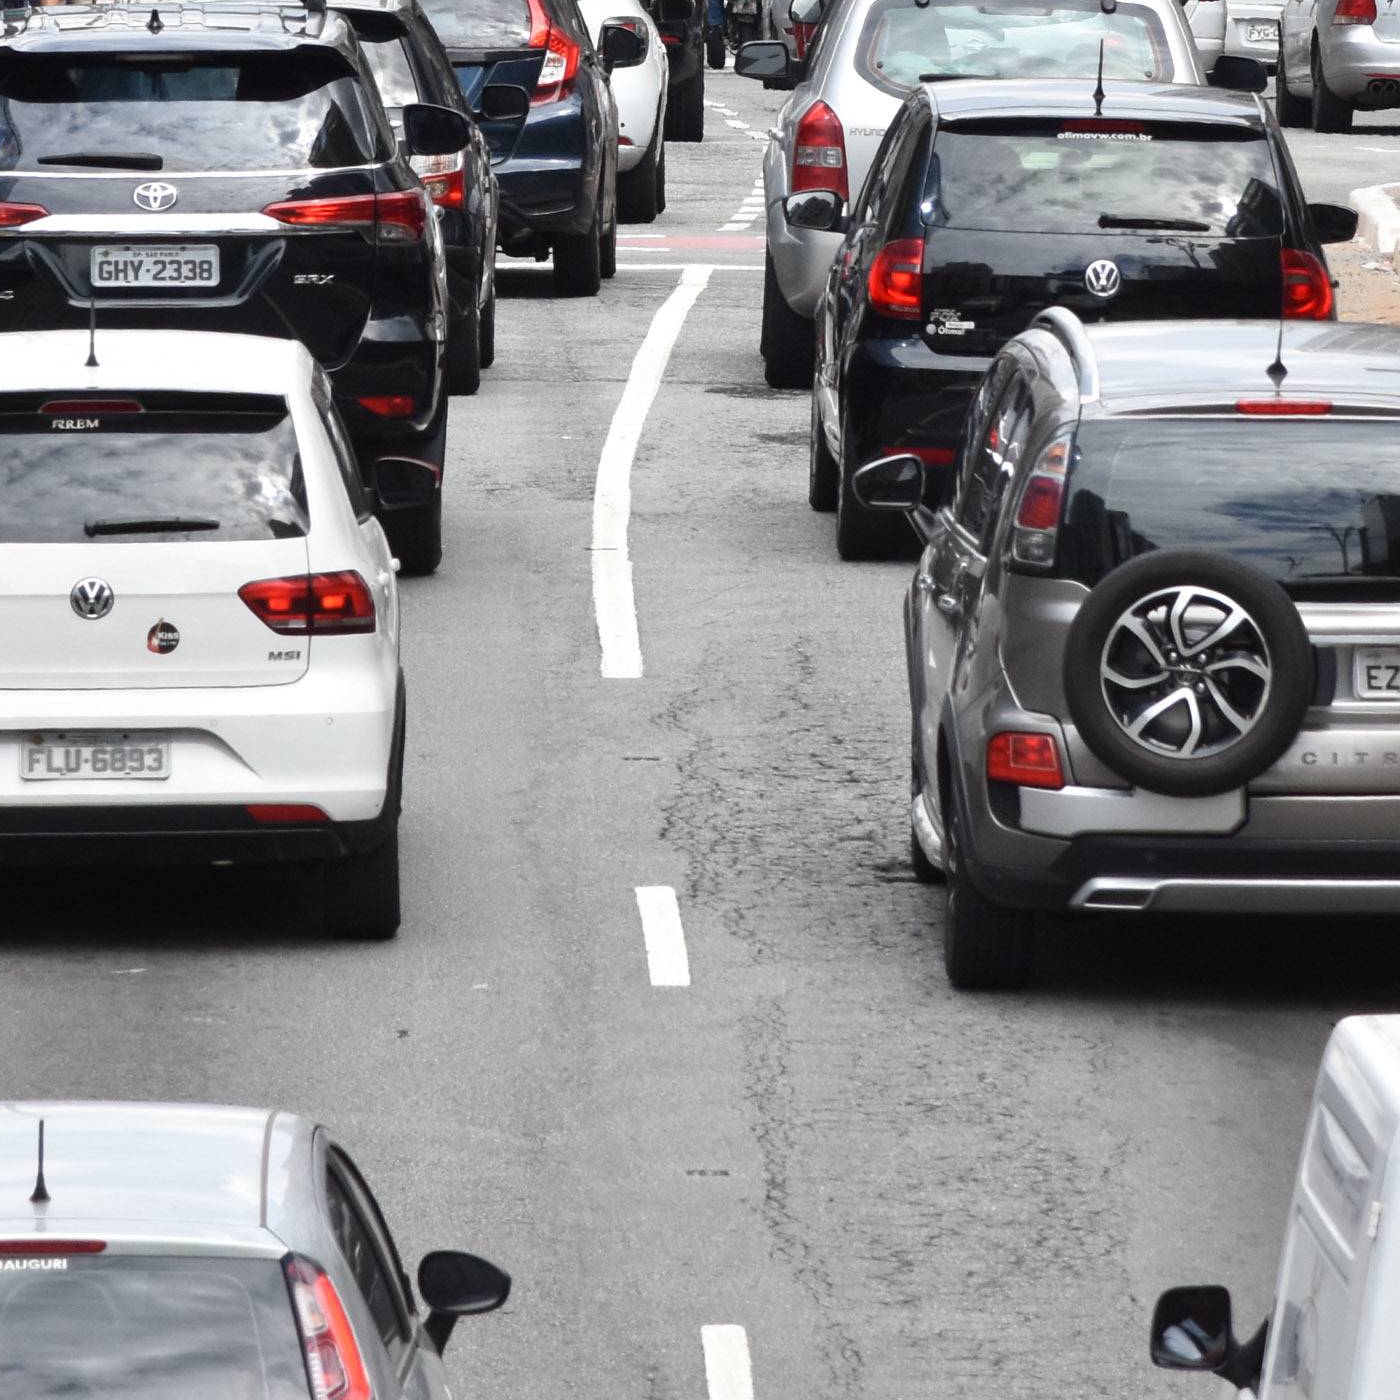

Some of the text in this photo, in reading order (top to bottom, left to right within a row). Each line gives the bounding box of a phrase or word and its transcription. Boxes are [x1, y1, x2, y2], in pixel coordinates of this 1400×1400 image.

[1056, 131, 1153, 142] otimavw.com.br
[267, 651, 302, 662] MSI
[2, 1258, 68, 1271] AUGURI
